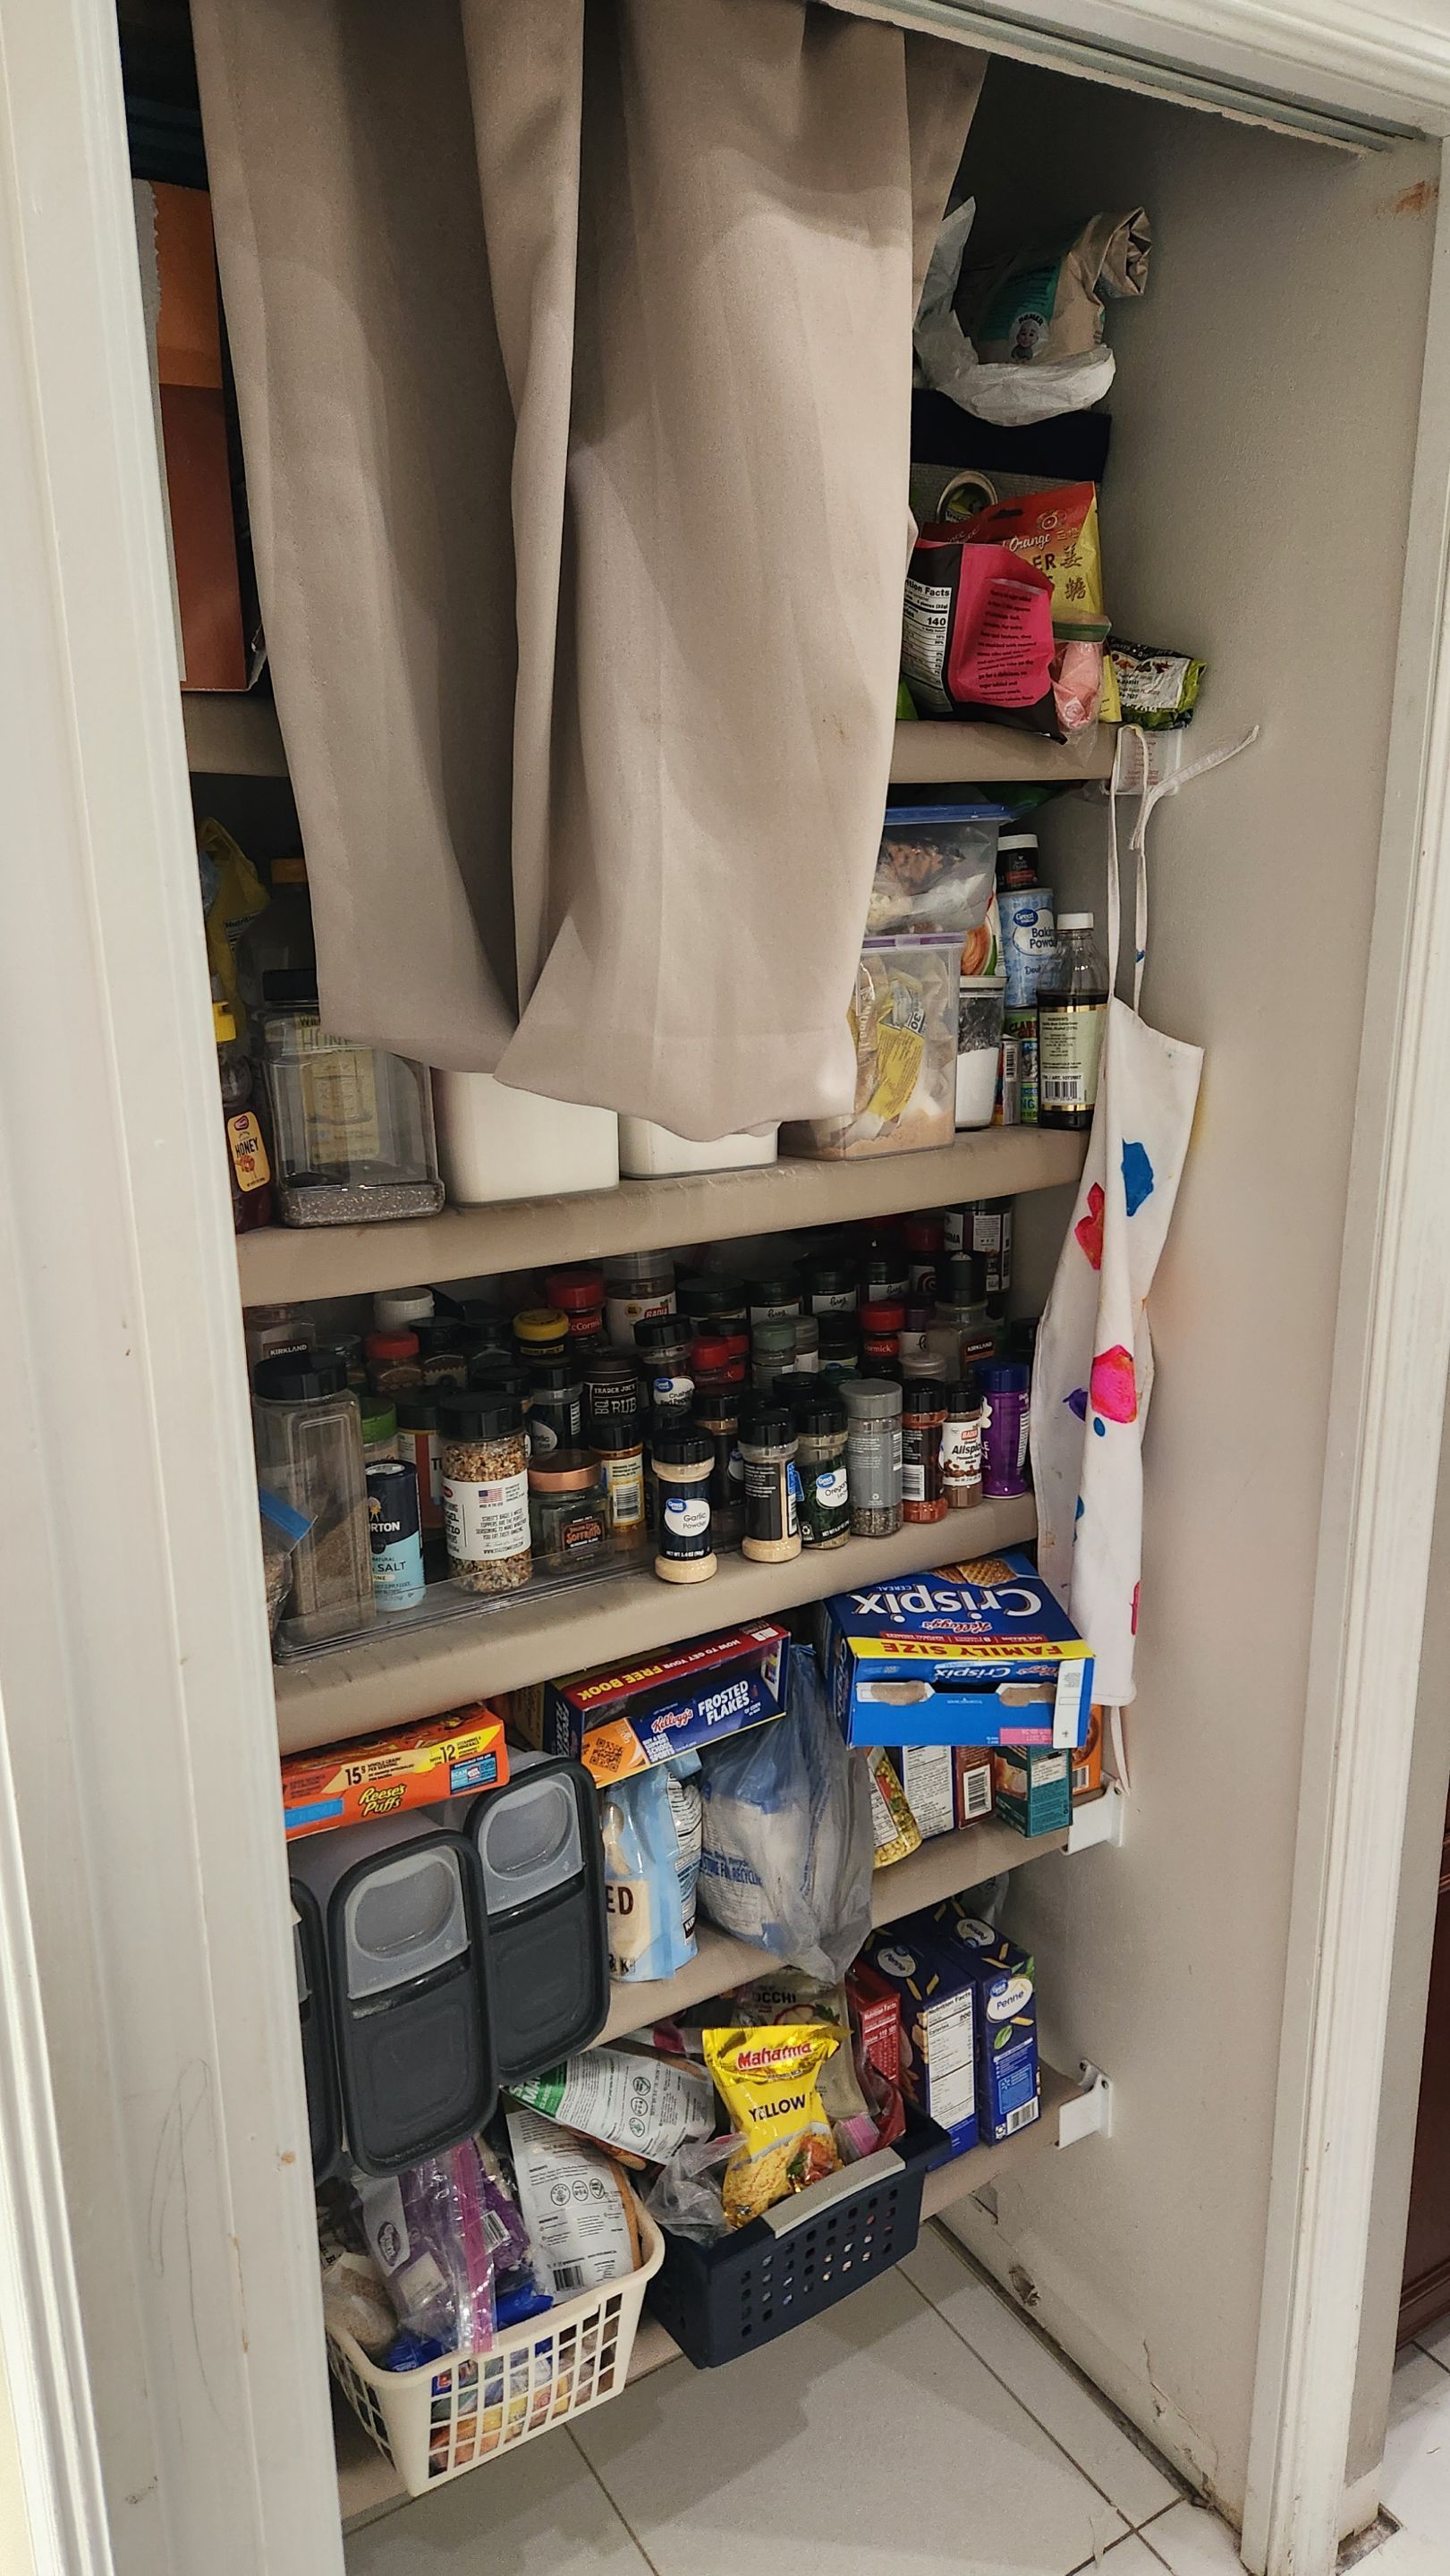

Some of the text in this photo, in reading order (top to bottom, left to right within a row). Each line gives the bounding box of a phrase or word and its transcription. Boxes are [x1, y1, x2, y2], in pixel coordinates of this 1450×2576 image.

[1009, 534, 1050, 552] Orange
[925, 587, 950, 597] Facts
[927, 617, 946, 626] 140
[234, 1137, 259, 1158] HONEY
[270, 1344, 307, 1356] KIRKLAND
[967, 1342, 993, 1352] KIRKLAND
[612, 1397, 637, 1414] RUB
[952, 1443, 981, 1455] Allspic
[683, 1512, 707, 1522] Garlic
[371, 1521, 401, 1532] RTON
[683, 1521, 707, 1530] Powder
[378, 1561, 407, 1572] SALT
[876, 1584, 912, 1592] CEREAL
[851, 1585, 1042, 1623] Crispix
[921, 1618, 992, 1633] Kellogg's
[881, 1642, 1064, 1657] FAMILY SIZE
[577, 1639, 741, 1701] HOW TO GET YOUR FREE BOOK
[935, 1667, 1011, 1679] Crispix
[698, 1680, 749, 1716] FROSTED
[706, 1692, 750, 1726] FLAKES
[651, 1707, 694, 1733] Kellogg's
[440, 1744, 456, 1762] 12
[646, 1742, 673, 1757] SCHOOL
[649, 1749, 676, 1763] SPORTS
[368, 1759, 385, 1768] WHOLE
[377, 1762, 398, 1770] SERVING
[345, 1767, 362, 1785] 15
[359, 1784, 407, 1806] Reese's
[361, 1797, 403, 1818] Puffs
[929, 1993, 971, 2014] Nutrition Facts
[996, 1991, 1024, 2010] Penne
[736, 2041, 812, 2070] Mahatma
[749, 2094, 806, 2123] YELLOW
